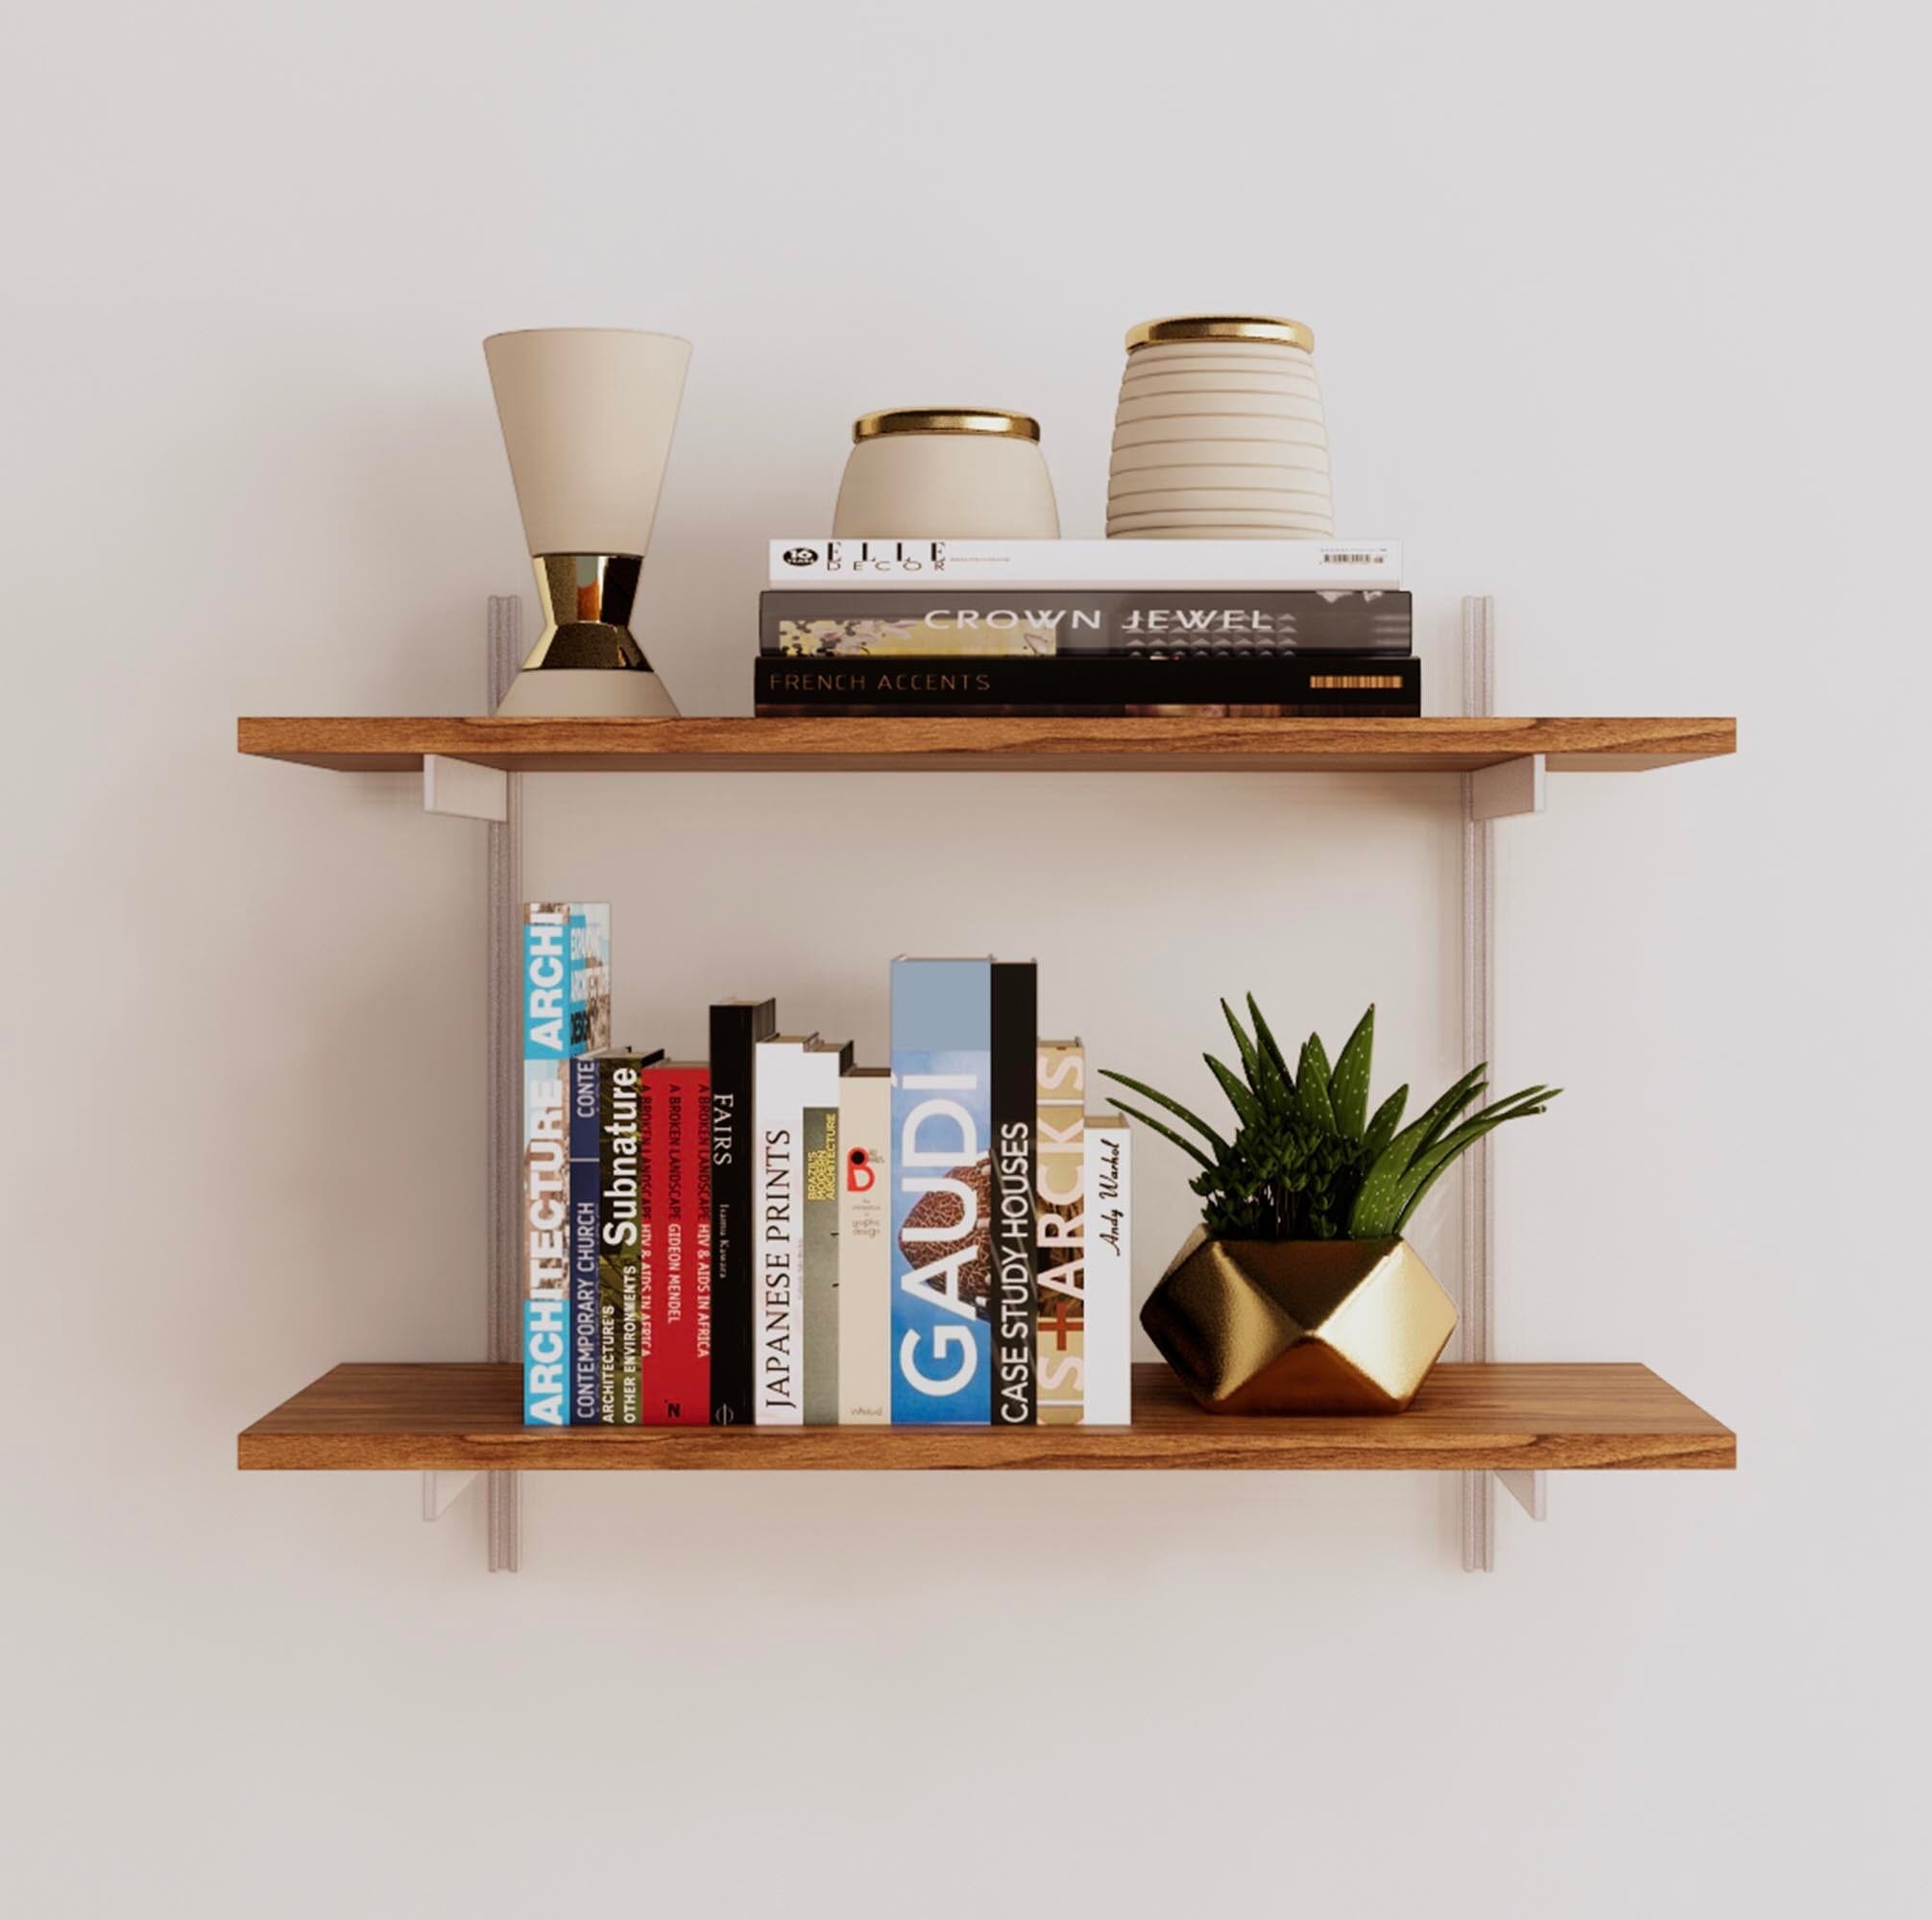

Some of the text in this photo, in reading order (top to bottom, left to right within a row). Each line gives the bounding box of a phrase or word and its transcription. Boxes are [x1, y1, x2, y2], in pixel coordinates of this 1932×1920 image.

[827, 561, 945, 571] DECOR
[828, 541, 946, 562] ELLE
[924, 610, 1273, 630] CROWN JEWEL
[770, 674, 991, 691] FRENCH ACCENTS
[577, 1057, 595, 1118] CONTE
[668, 1096, 681, 1145] BROKEN
[697, 1096, 711, 1145] BROKEN
[713, 1093, 734, 1165] FAIRS
[603, 1068, 638, 1246] Subnature
[668, 1149, 681, 1220] LANDSCAPE
[697, 1149, 711, 1220] LANDSCAPE
[826, 1113, 836, 1200] ARCHITECTURE
[1099, 1139, 1124, 1258] Andy Warhol
[529, 1079, 565, 1426] ARCHITECTURE
[668, 1223, 681, 1271] GIDEON
[697, 1223, 711, 1246] HIV
[668, 1274, 681, 1324] MENDEL
[697, 1262, 711, 1292] AIDS
[765, 1129, 796, 1408] JAPANESE PRINTS
[1001, 1121, 1028, 1424] CASE STUDY HOUSES
[577, 1202, 594, 1419] CONTEMPORARY CHURCH
[697, 1295, 711, 1309] IN
[602, 1305, 616, 1424] ARCHITECTURE'S
[623, 1264, 637, 1424] OTHER ENVIRONMENTS
[697, 1312, 711, 1358] AFRICA
